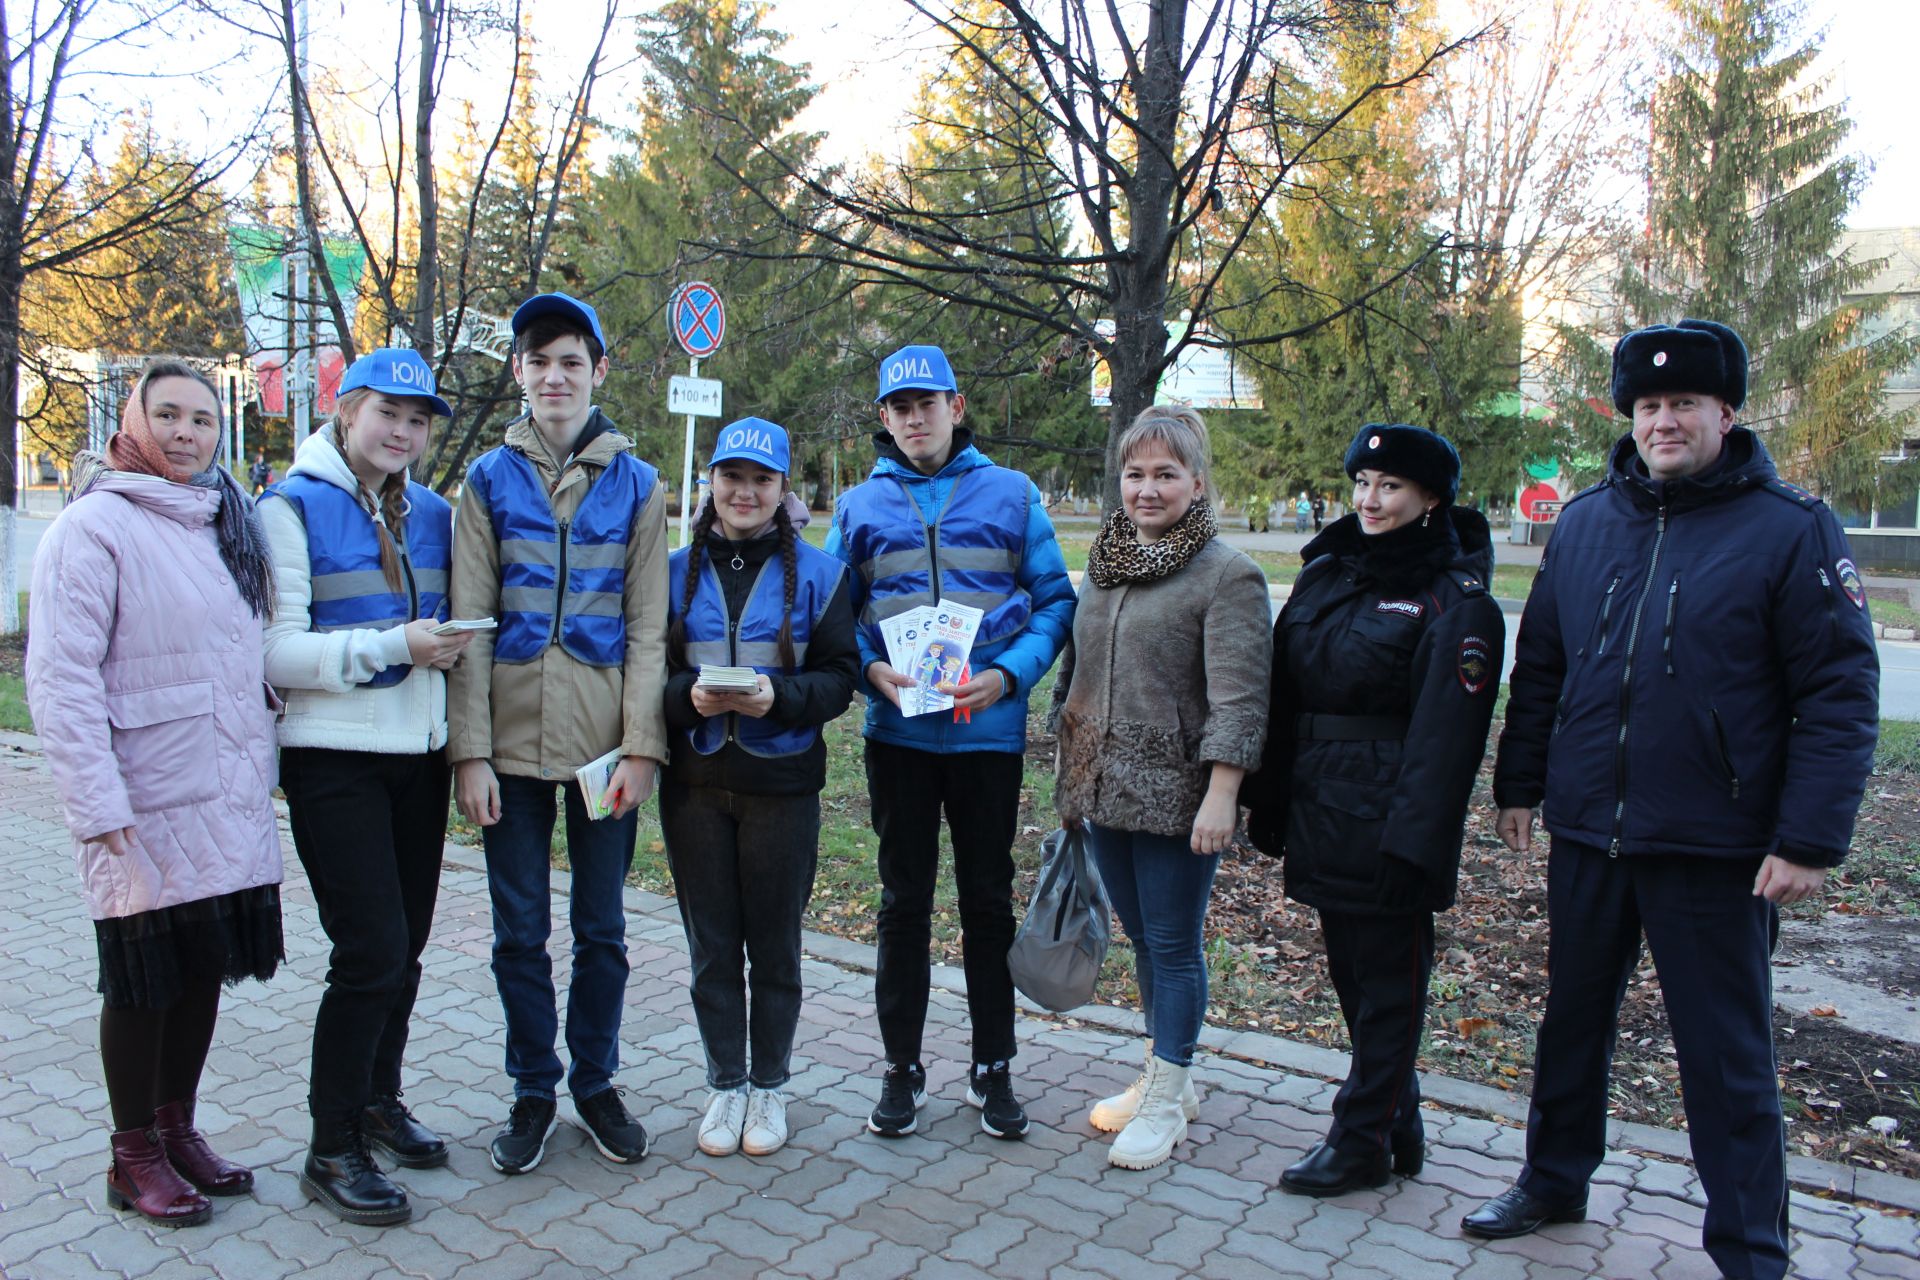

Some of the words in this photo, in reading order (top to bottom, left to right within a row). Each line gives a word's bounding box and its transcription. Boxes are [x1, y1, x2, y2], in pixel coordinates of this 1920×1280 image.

[392, 361, 432, 393] ЮИД
[888, 358, 933, 387] ЮИД
[681, 389, 699, 402] 100
[725, 428, 773, 456] ЮИД
[1378, 602, 1420, 615] ПОЛИЦИЯ
